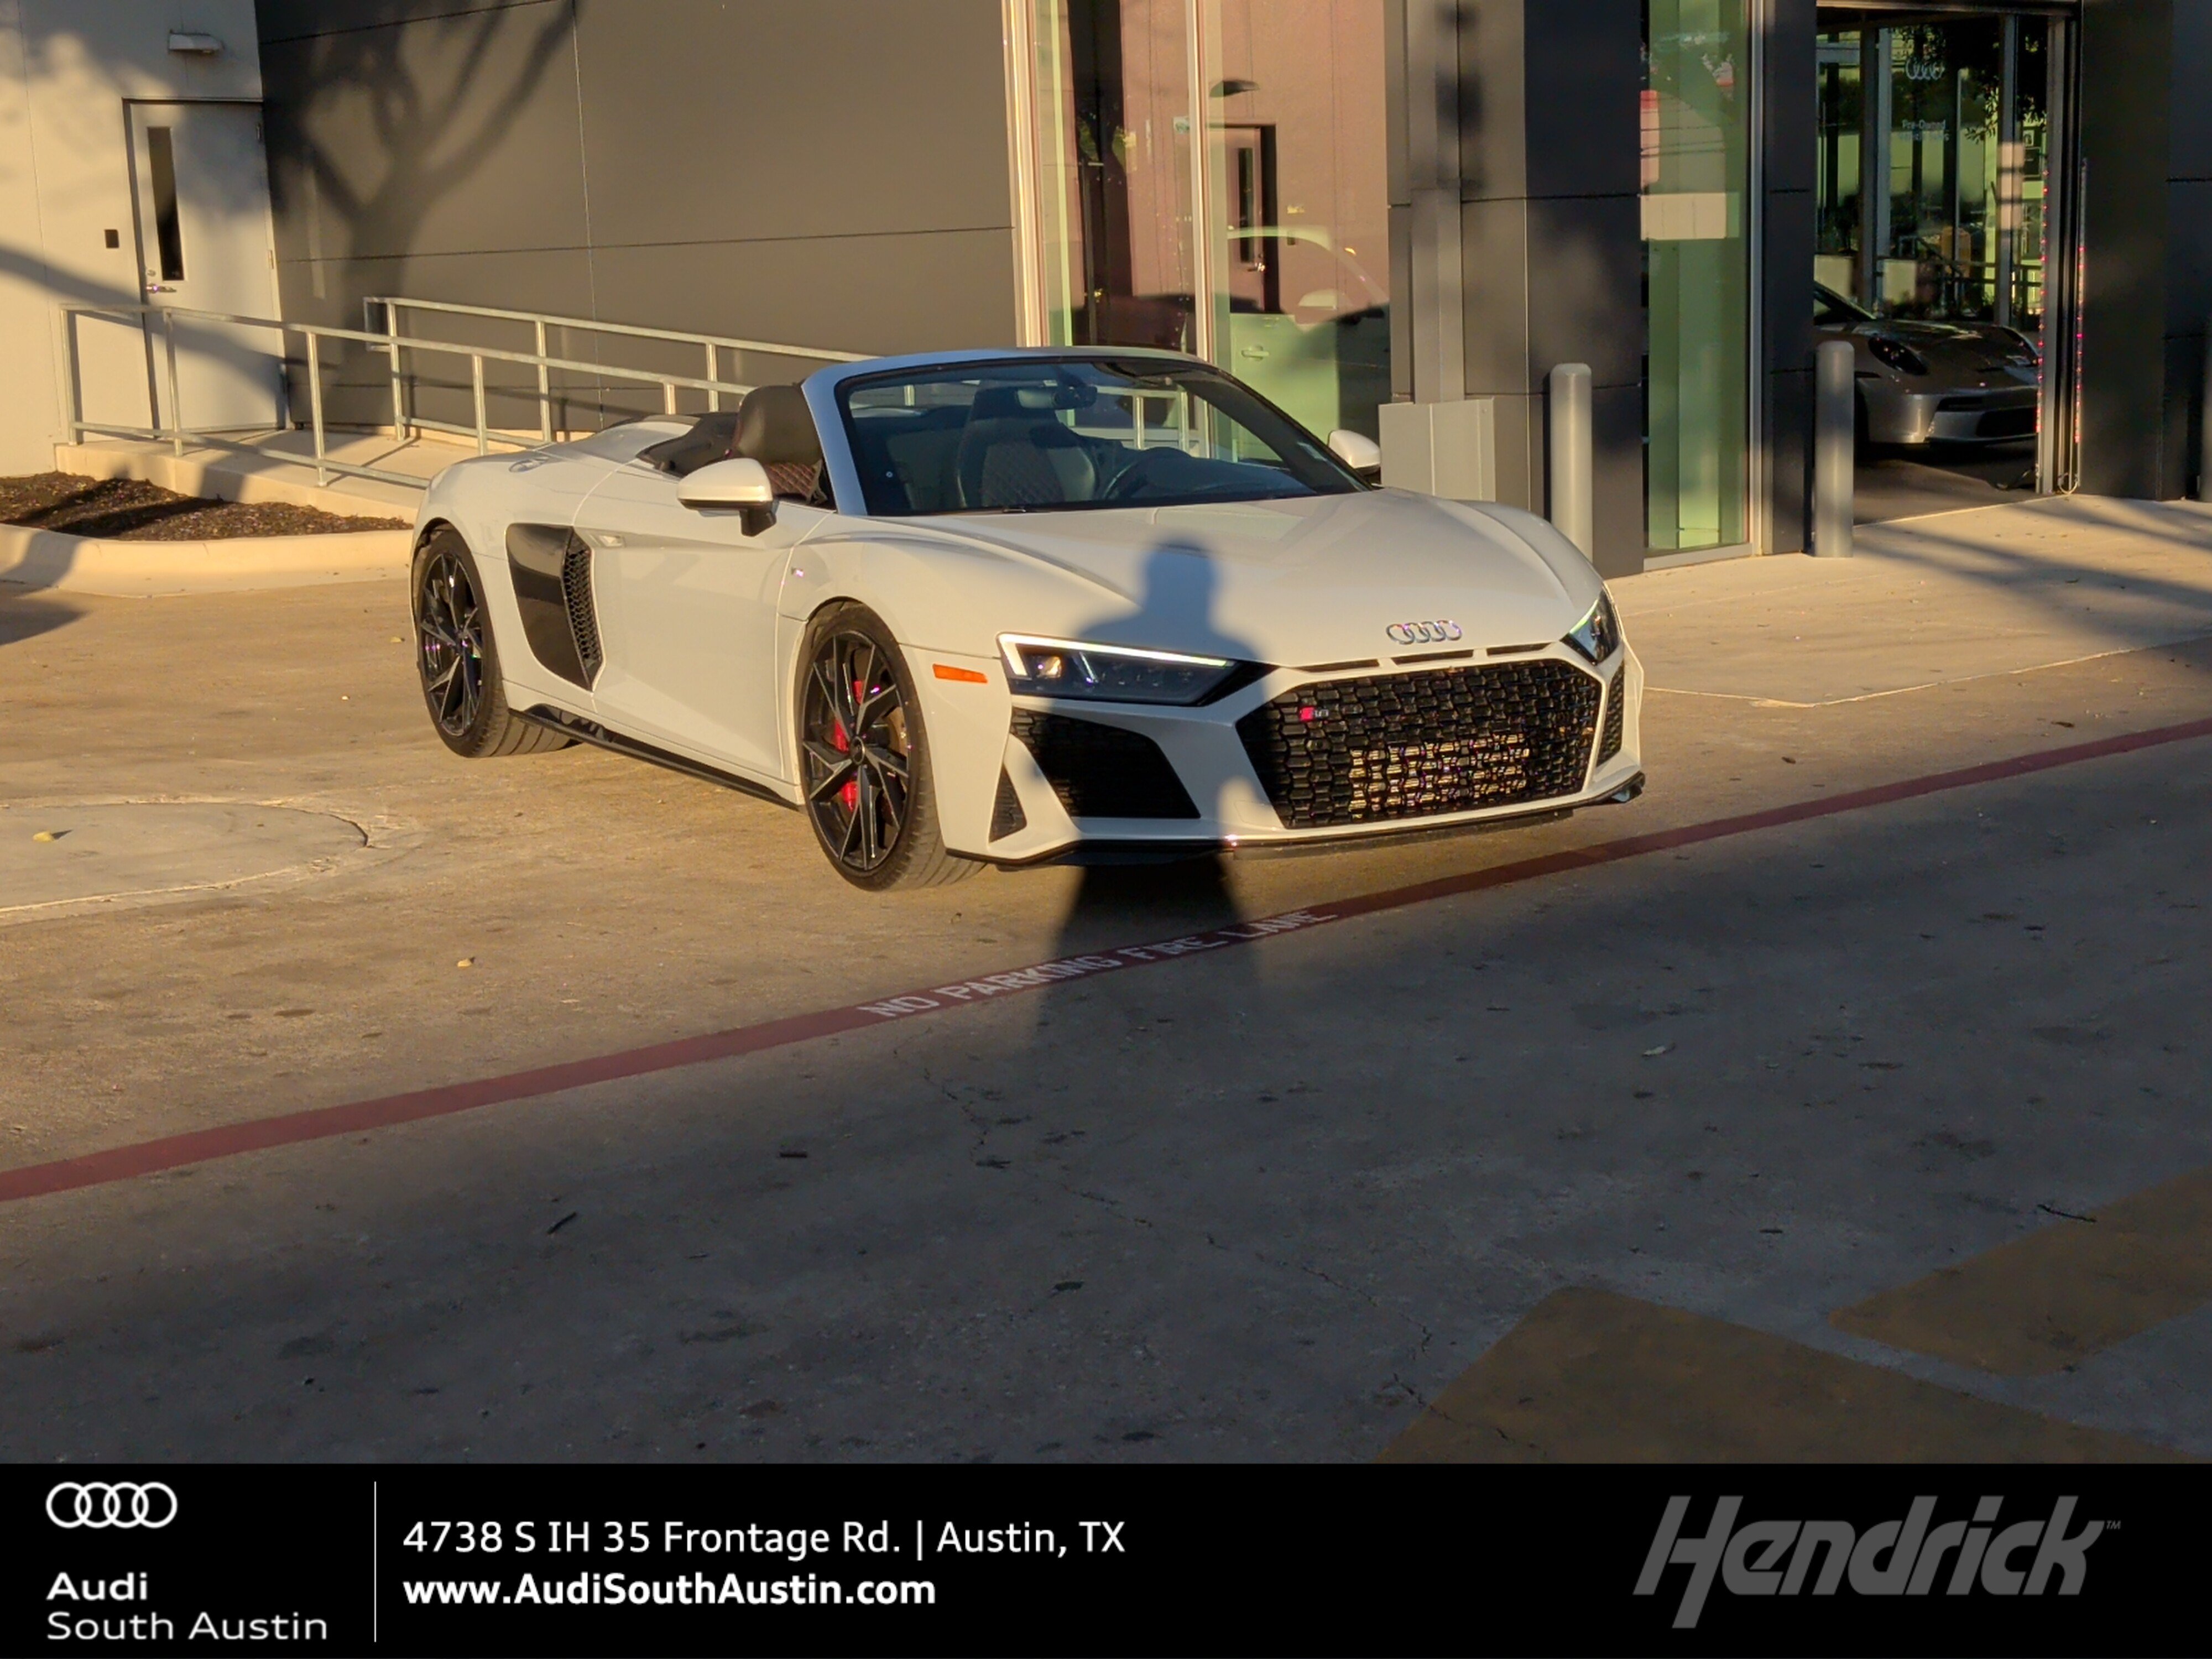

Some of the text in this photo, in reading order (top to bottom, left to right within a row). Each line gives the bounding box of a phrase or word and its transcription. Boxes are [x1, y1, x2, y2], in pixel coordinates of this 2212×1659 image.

[857, 910, 1338, 1017] NO PARKING FIRE LANE
